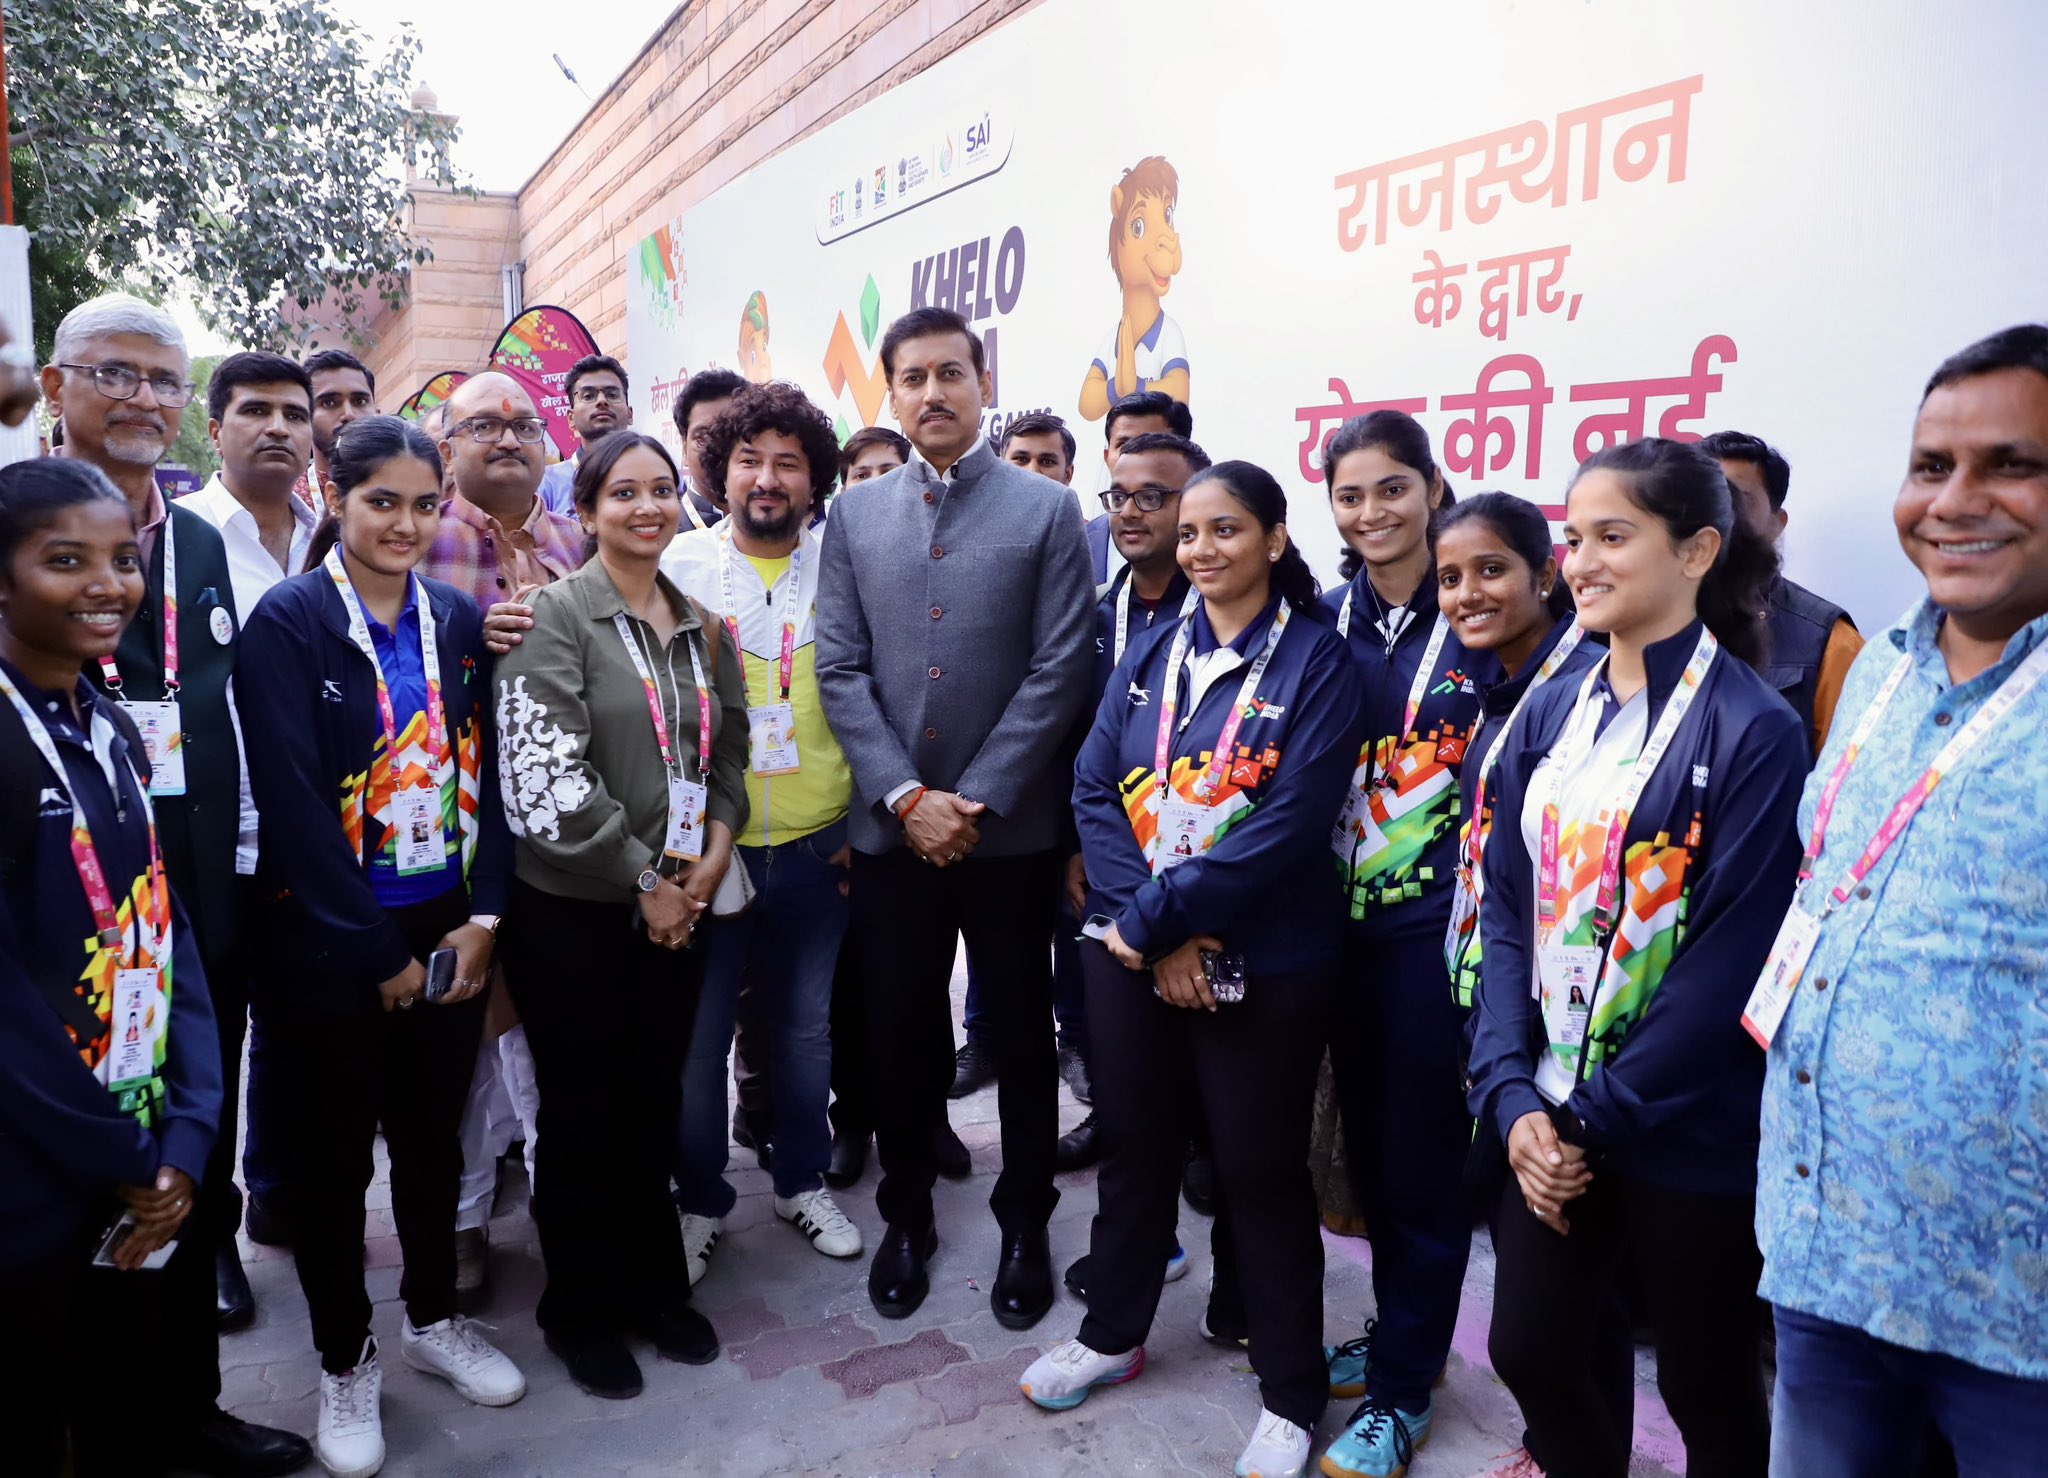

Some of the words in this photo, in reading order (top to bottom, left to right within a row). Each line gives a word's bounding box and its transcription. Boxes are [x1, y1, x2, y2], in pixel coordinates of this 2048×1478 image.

[966, 112, 990, 153] SAI
[1334, 73, 1704, 253] राजस्थान
[910, 226, 1026, 322] KHELO
[1411, 250, 1468, 328] के
[1477, 244, 1583, 341] द्वार,
[1440, 354, 1554, 480] की
